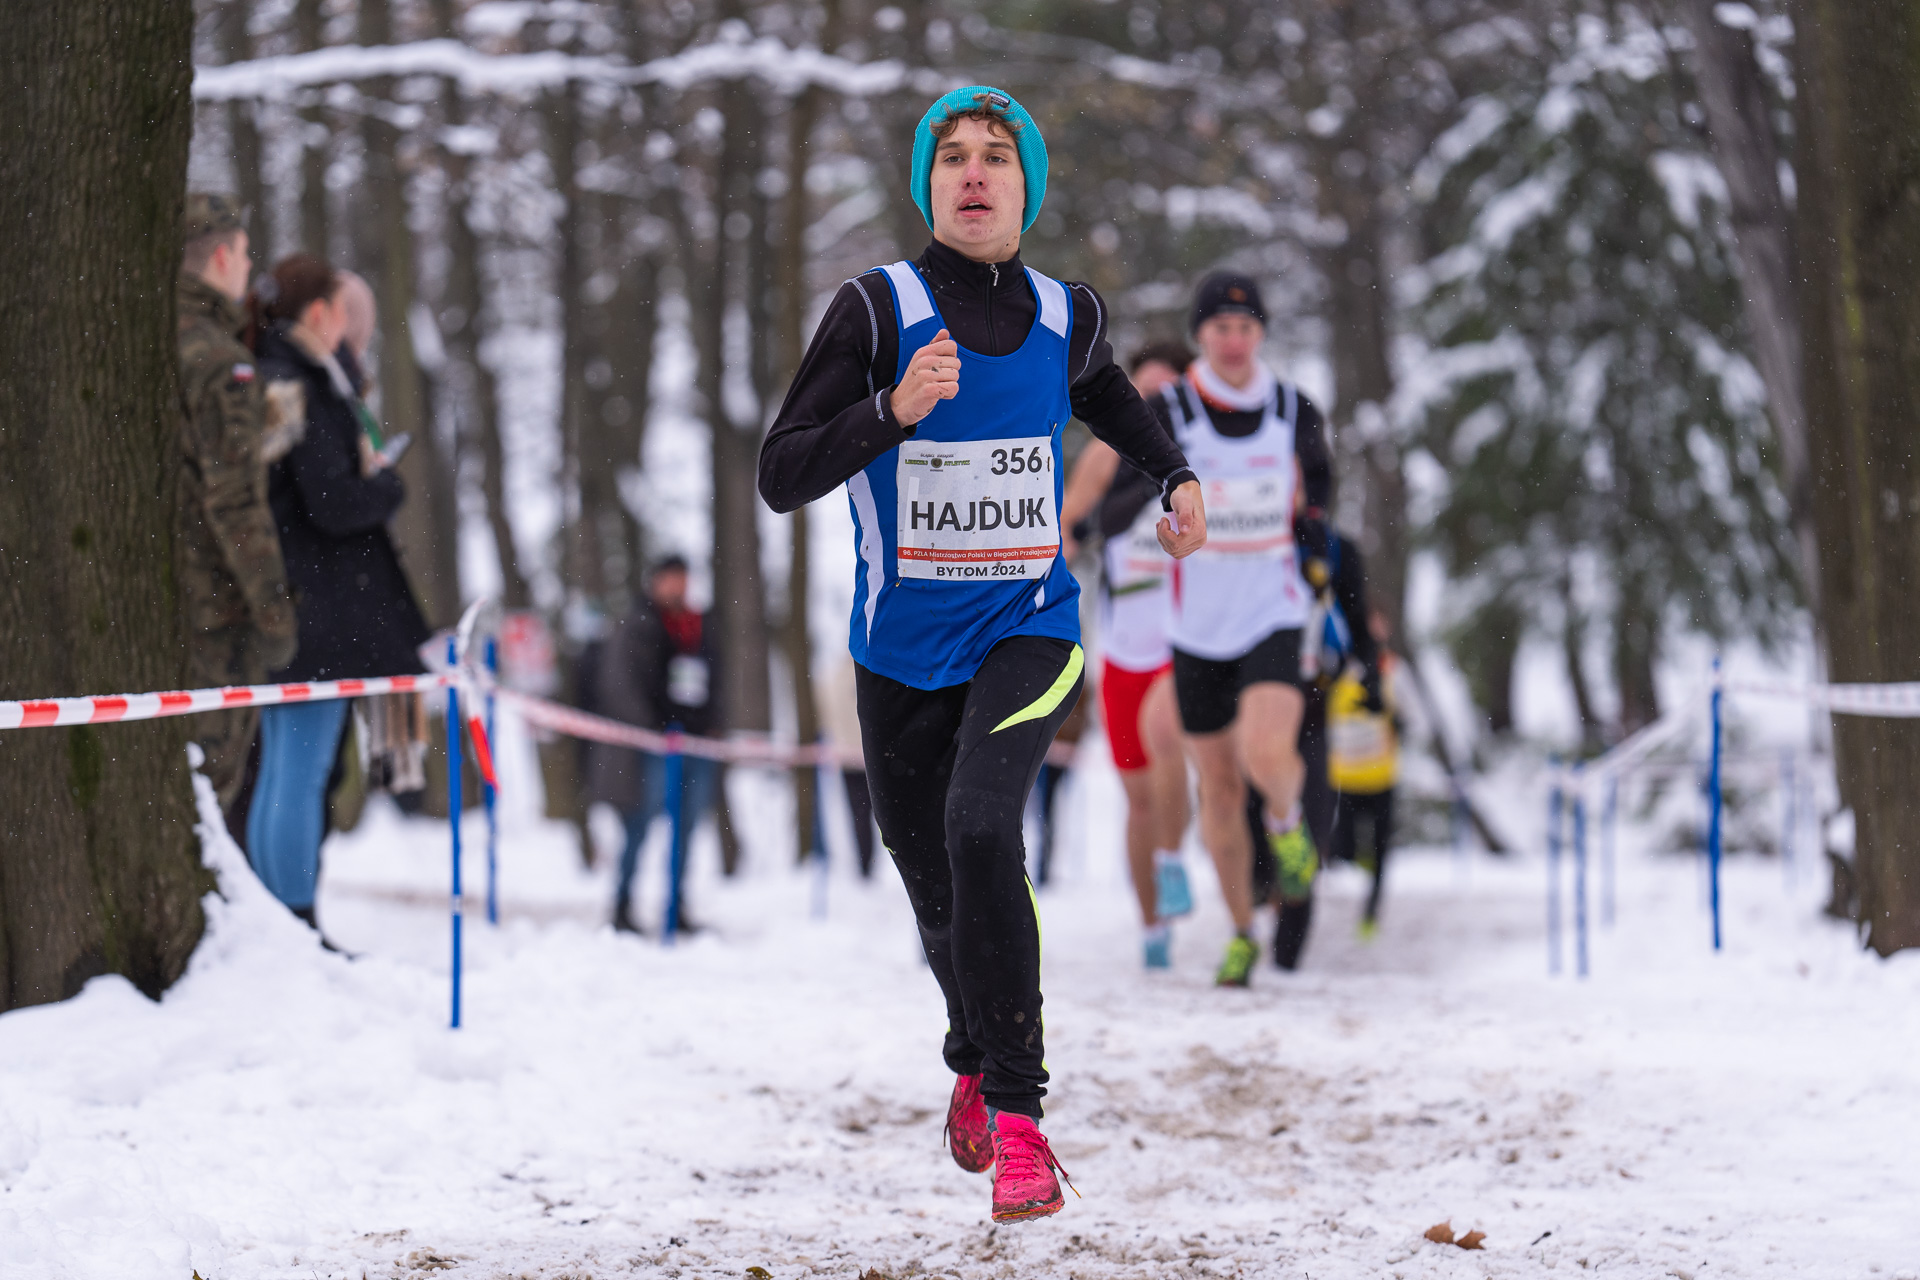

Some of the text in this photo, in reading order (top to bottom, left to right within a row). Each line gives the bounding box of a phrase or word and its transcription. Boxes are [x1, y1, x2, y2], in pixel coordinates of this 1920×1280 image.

[991, 447, 1042, 475] 356
[911, 497, 1047, 531] HAJDUK
[930, 551, 966, 559] Mistrzostwa
[937, 565, 1025, 576] BYTOM 2024
